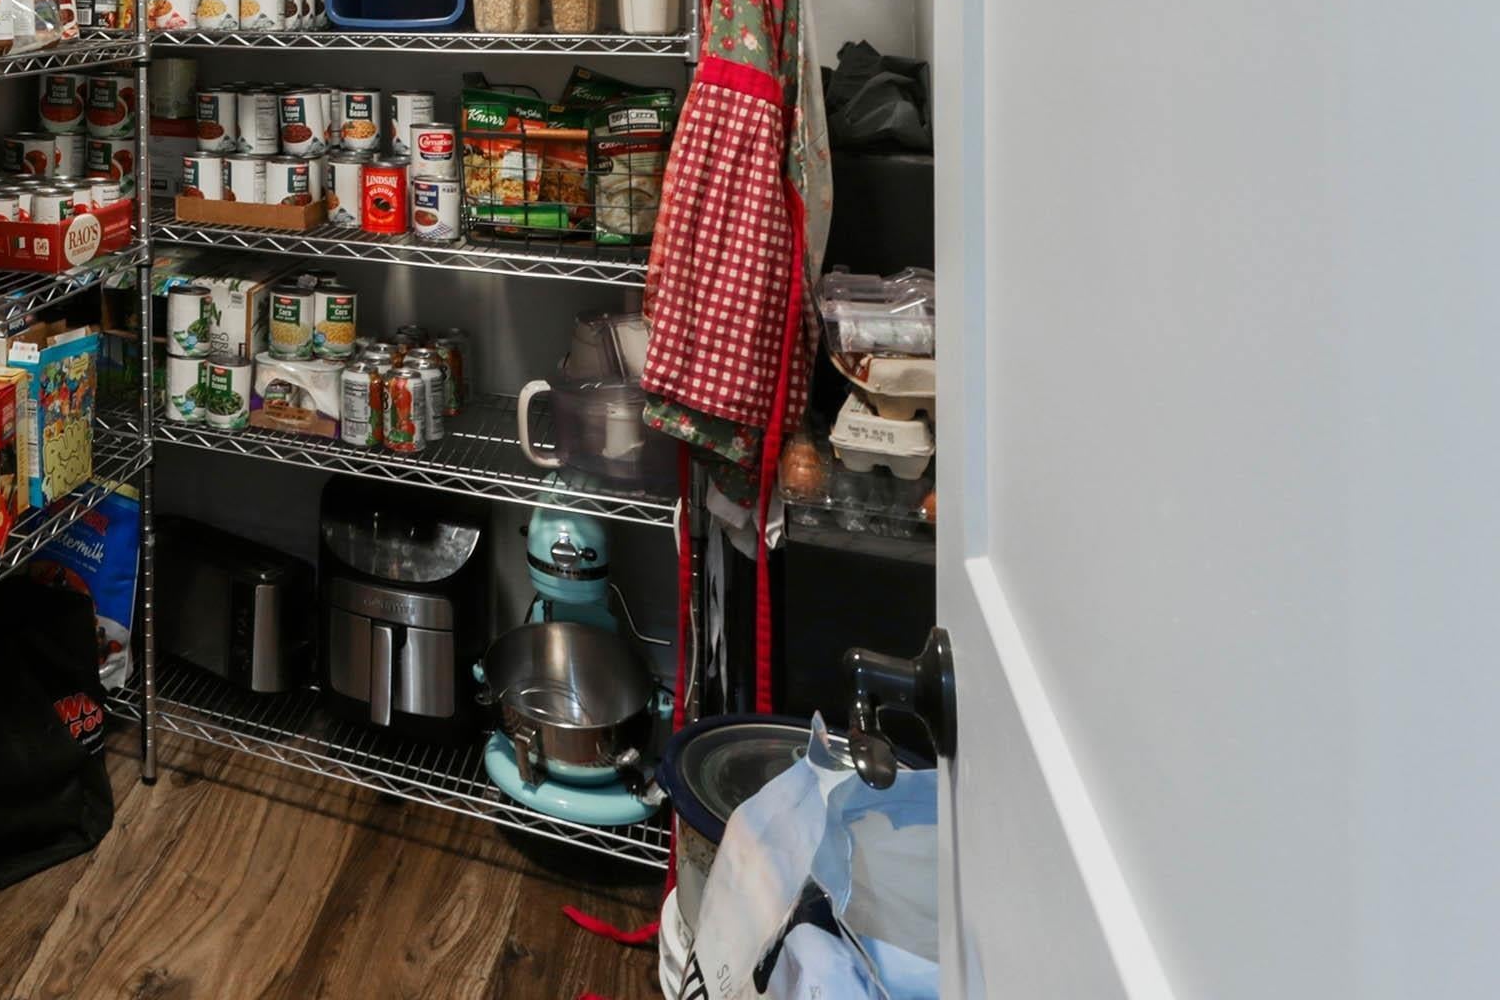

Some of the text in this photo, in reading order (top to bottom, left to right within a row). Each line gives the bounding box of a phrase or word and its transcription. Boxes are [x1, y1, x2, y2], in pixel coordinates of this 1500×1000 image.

[350, 101, 367, 110] Pinto
[467, 105, 505, 127] Knorr
[366, 175, 399, 188] LINDSAY
[369, 186, 395, 198] MEDIUM
[68, 223, 100, 250] RAO'S
